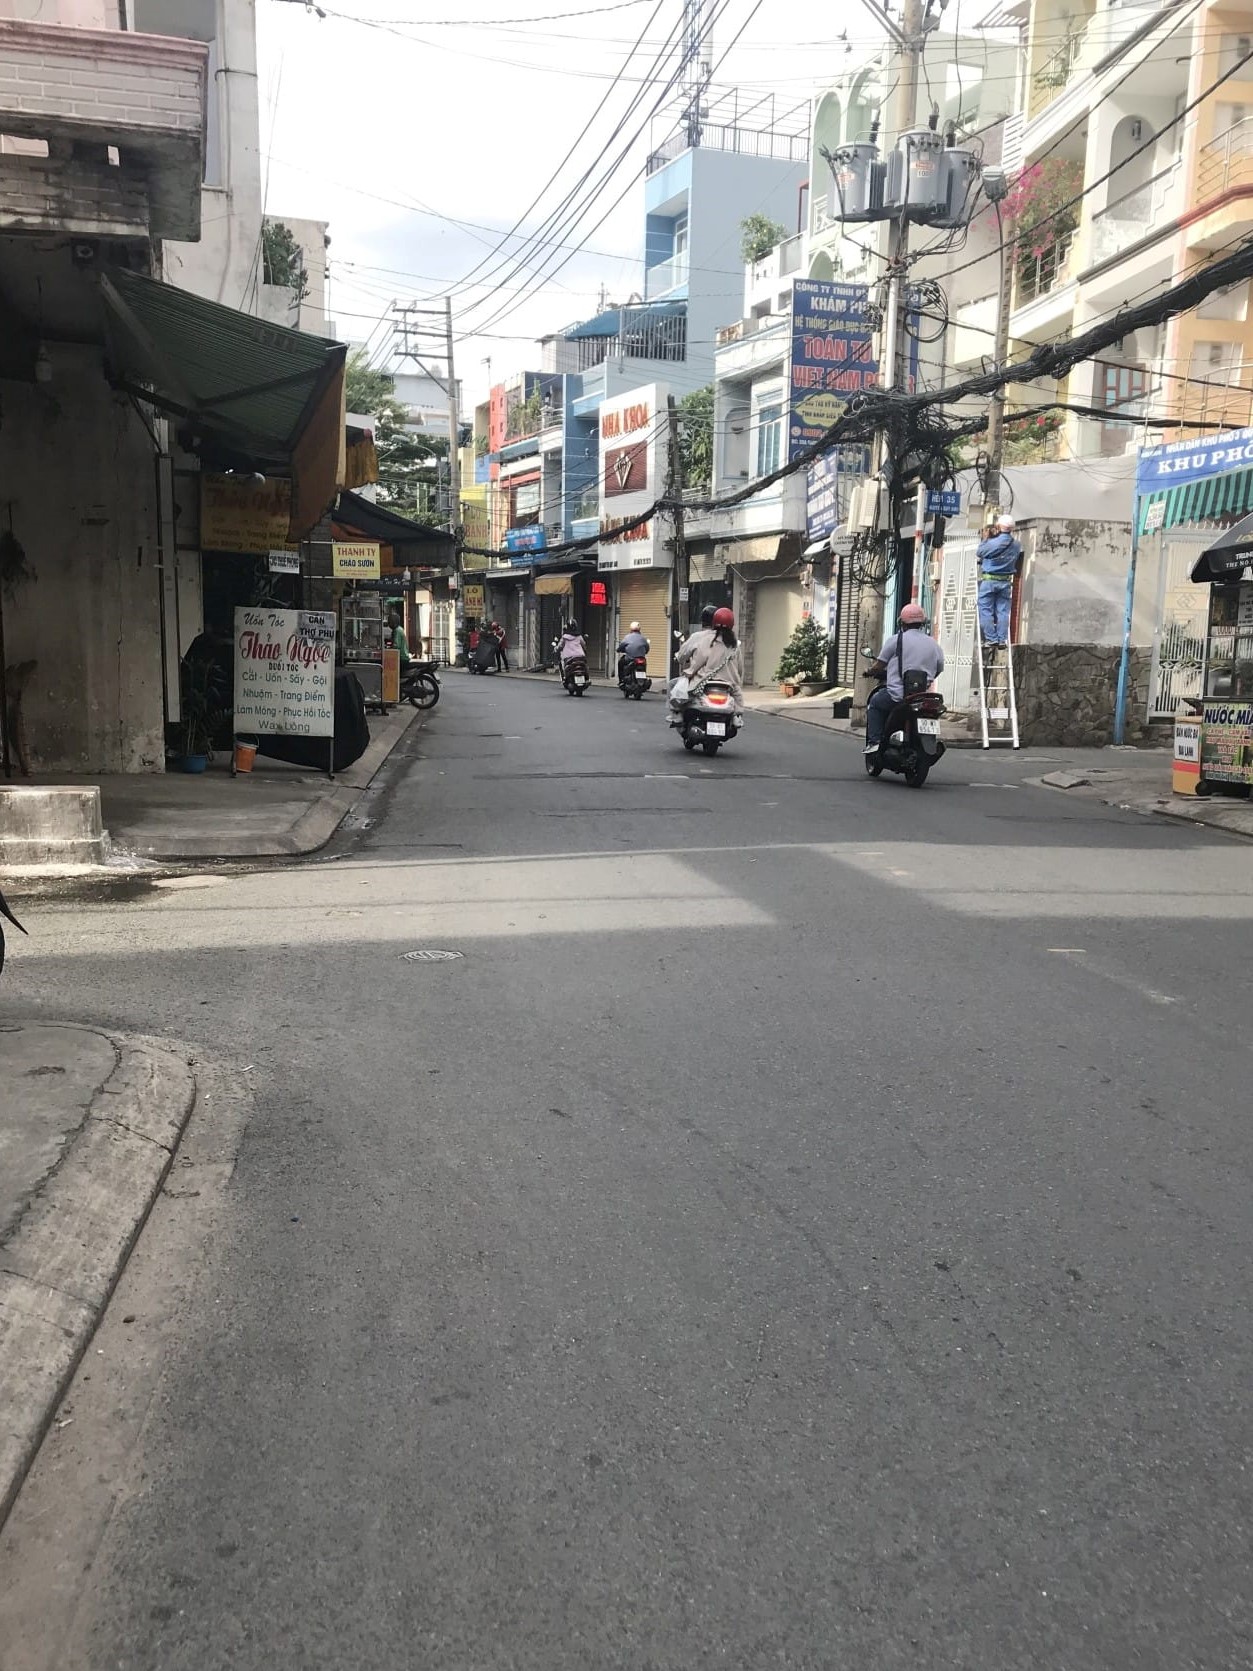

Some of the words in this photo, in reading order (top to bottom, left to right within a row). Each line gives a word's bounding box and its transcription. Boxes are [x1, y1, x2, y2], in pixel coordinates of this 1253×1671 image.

[795, 282, 818, 292] CÔNG
[821, 286, 830, 294] TY
[833, 287, 854, 296] TNHH
[811, 296, 846, 312] KHÁM
[805, 314, 827, 330] THỐNG
[803, 334, 847, 362] TOÁN
[827, 368, 861, 392] NAM
[602, 411, 620, 439] NHA
[624, 402, 648, 433] KHOA
[1166, 443, 1185, 454] NHÂN
[1186, 438, 1200, 451] DÂN
[1202, 436, 1218, 447] KHU
[1157, 453, 1207, 474] KHU
[337, 547, 365, 557] THANH
[367, 547, 376, 557] TY
[244, 612, 264, 625] Uốn
[268, 613, 285, 627] Tóc
[239, 630, 282, 660] Thảo
[286, 634, 331, 670] Ngọc
[242, 667, 257, 681] Cắt
[265, 671, 282, 683] Uốn
[289, 673, 304, 685] Sấy
[312, 675, 327, 687] Gội
[243, 688, 272, 699] Nhuộm
[280, 690, 302, 702] Trang
[305, 689, 325, 702] Điểm
[255, 705, 276, 717] Móng
[283, 706, 302, 719] Phục
[317, 705, 331, 718] Tóc
[1204, 706, 1234, 725] NƯỚC
